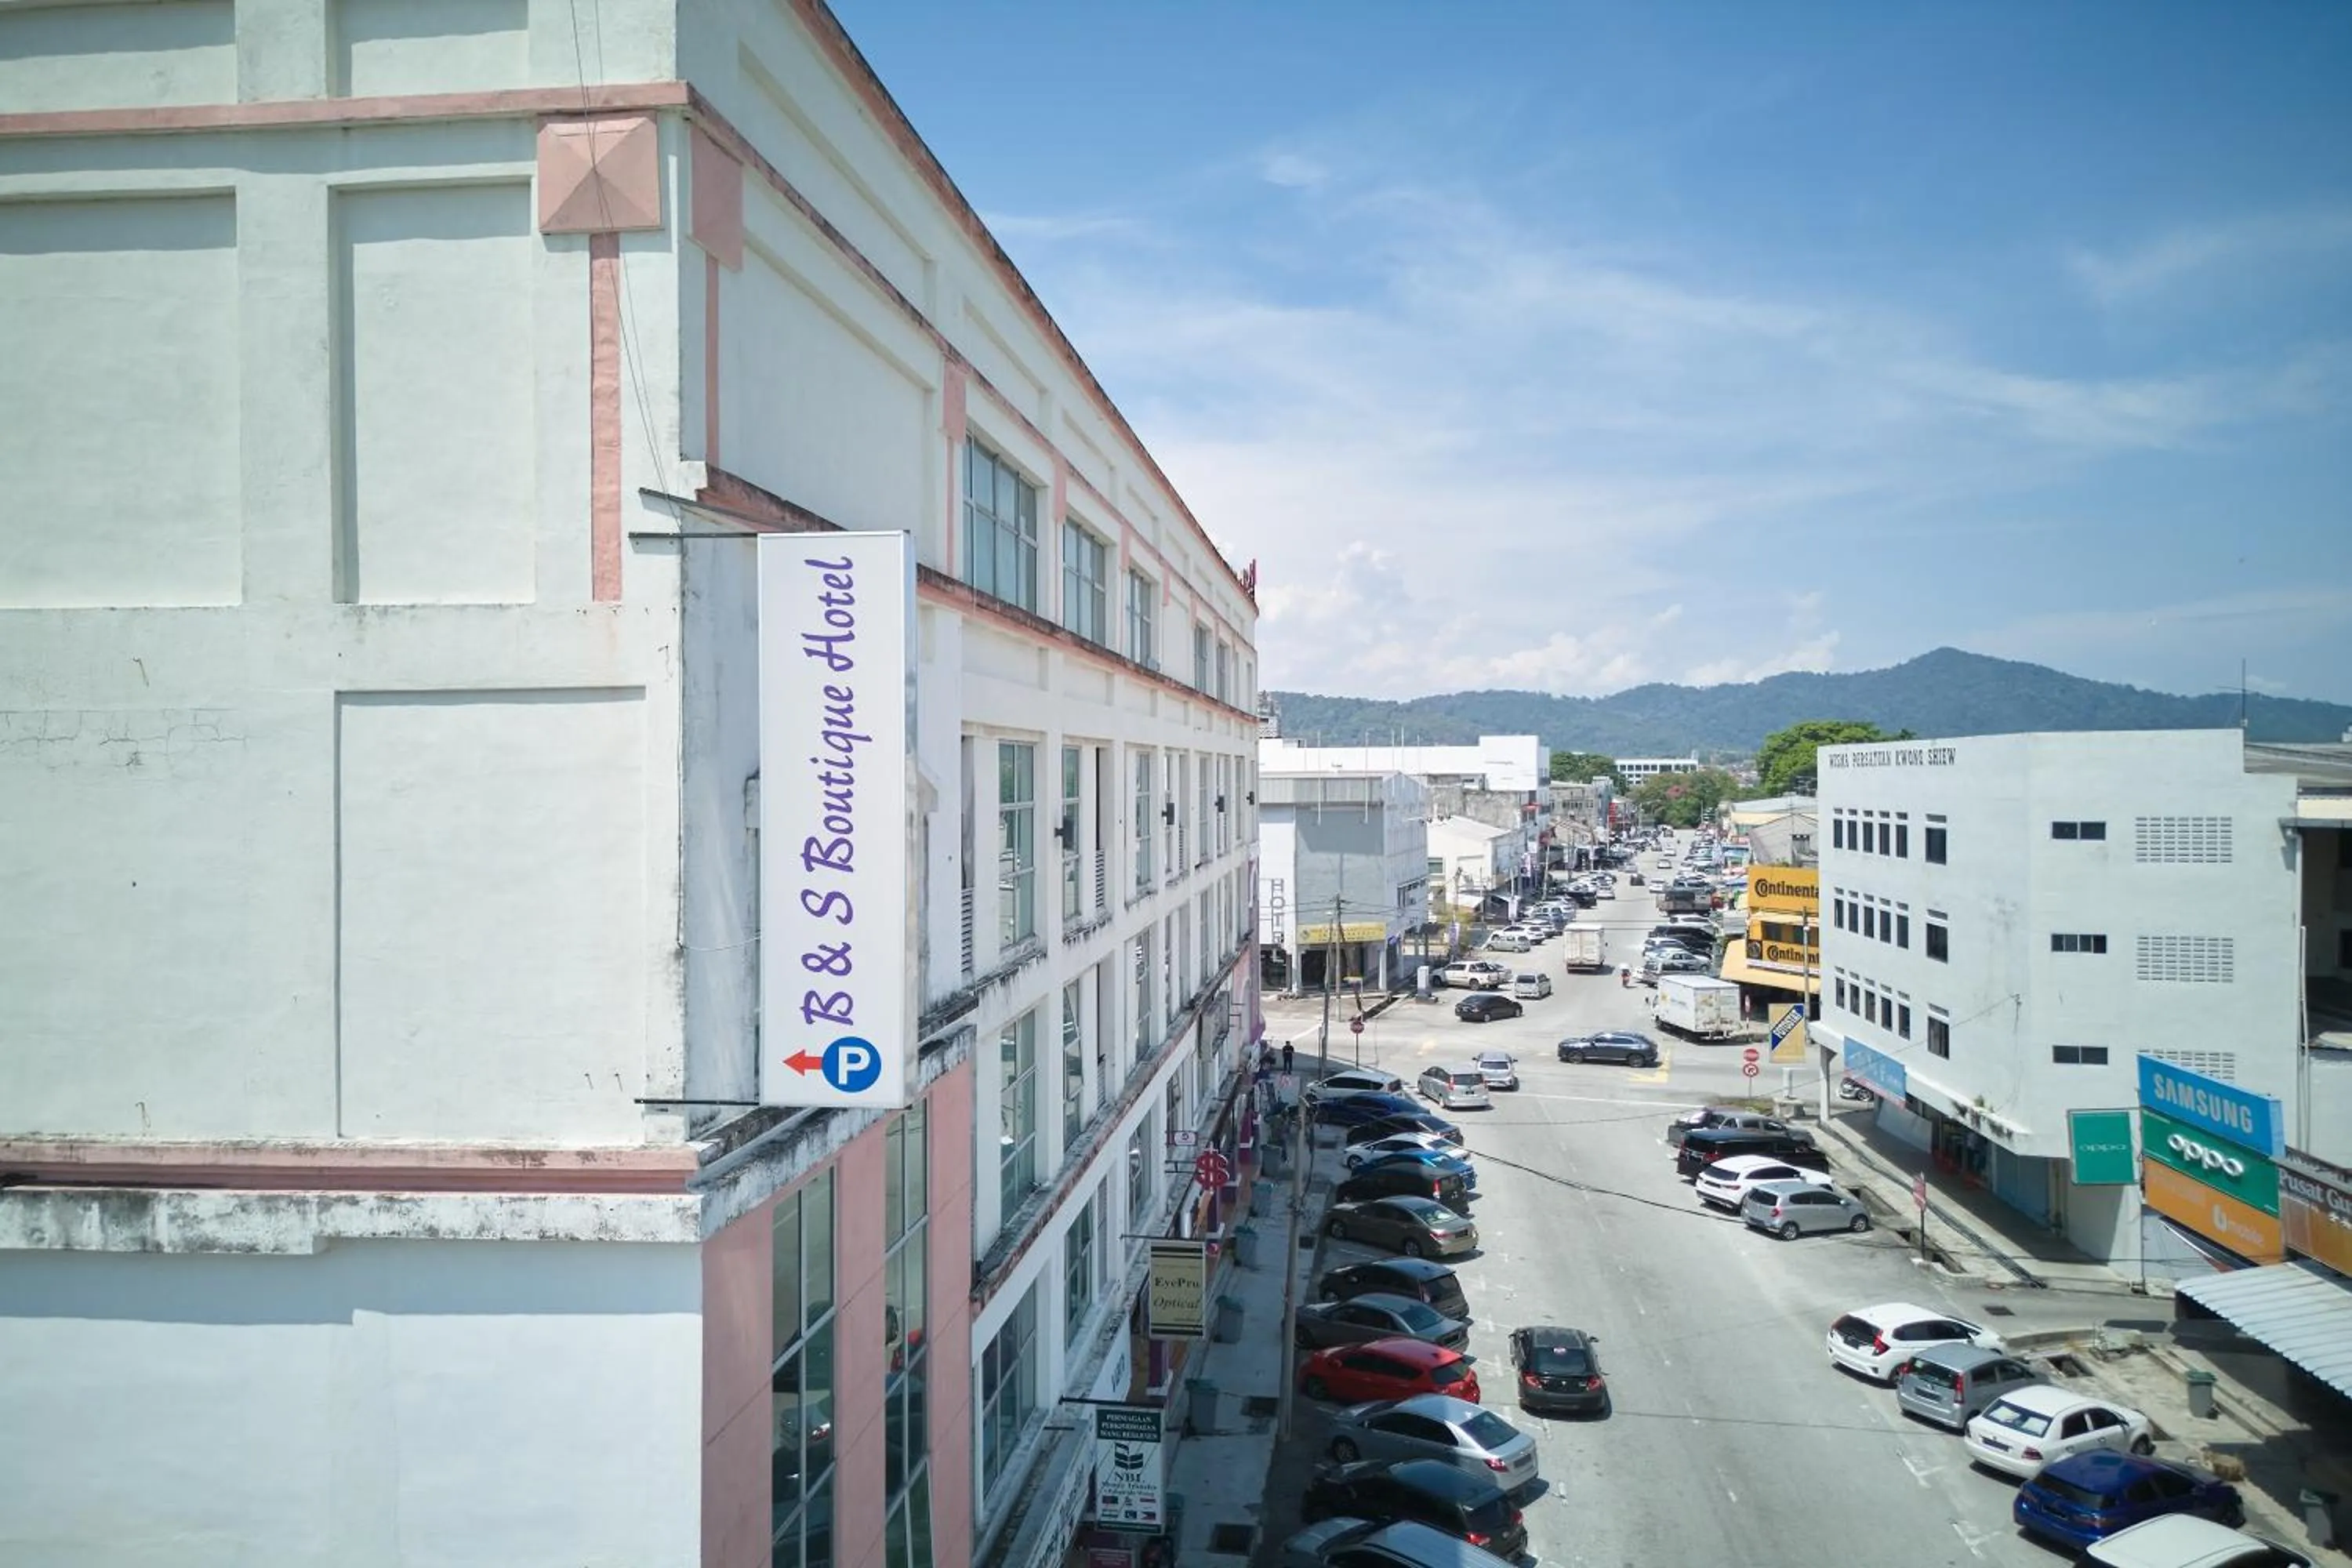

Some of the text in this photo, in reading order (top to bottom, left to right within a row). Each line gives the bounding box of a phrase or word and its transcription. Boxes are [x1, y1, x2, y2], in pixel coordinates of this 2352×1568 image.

[1928, 747, 1956, 765] SHIEW
[800, 556, 872, 1026] B & S Boutique Hotel
[838, 1047, 869, 1084] P
[2153, 1073, 2254, 1134] SAMSUNG
[2278, 1167, 2325, 1203] Pusat
[1153, 1296, 1201, 1310] Optical
